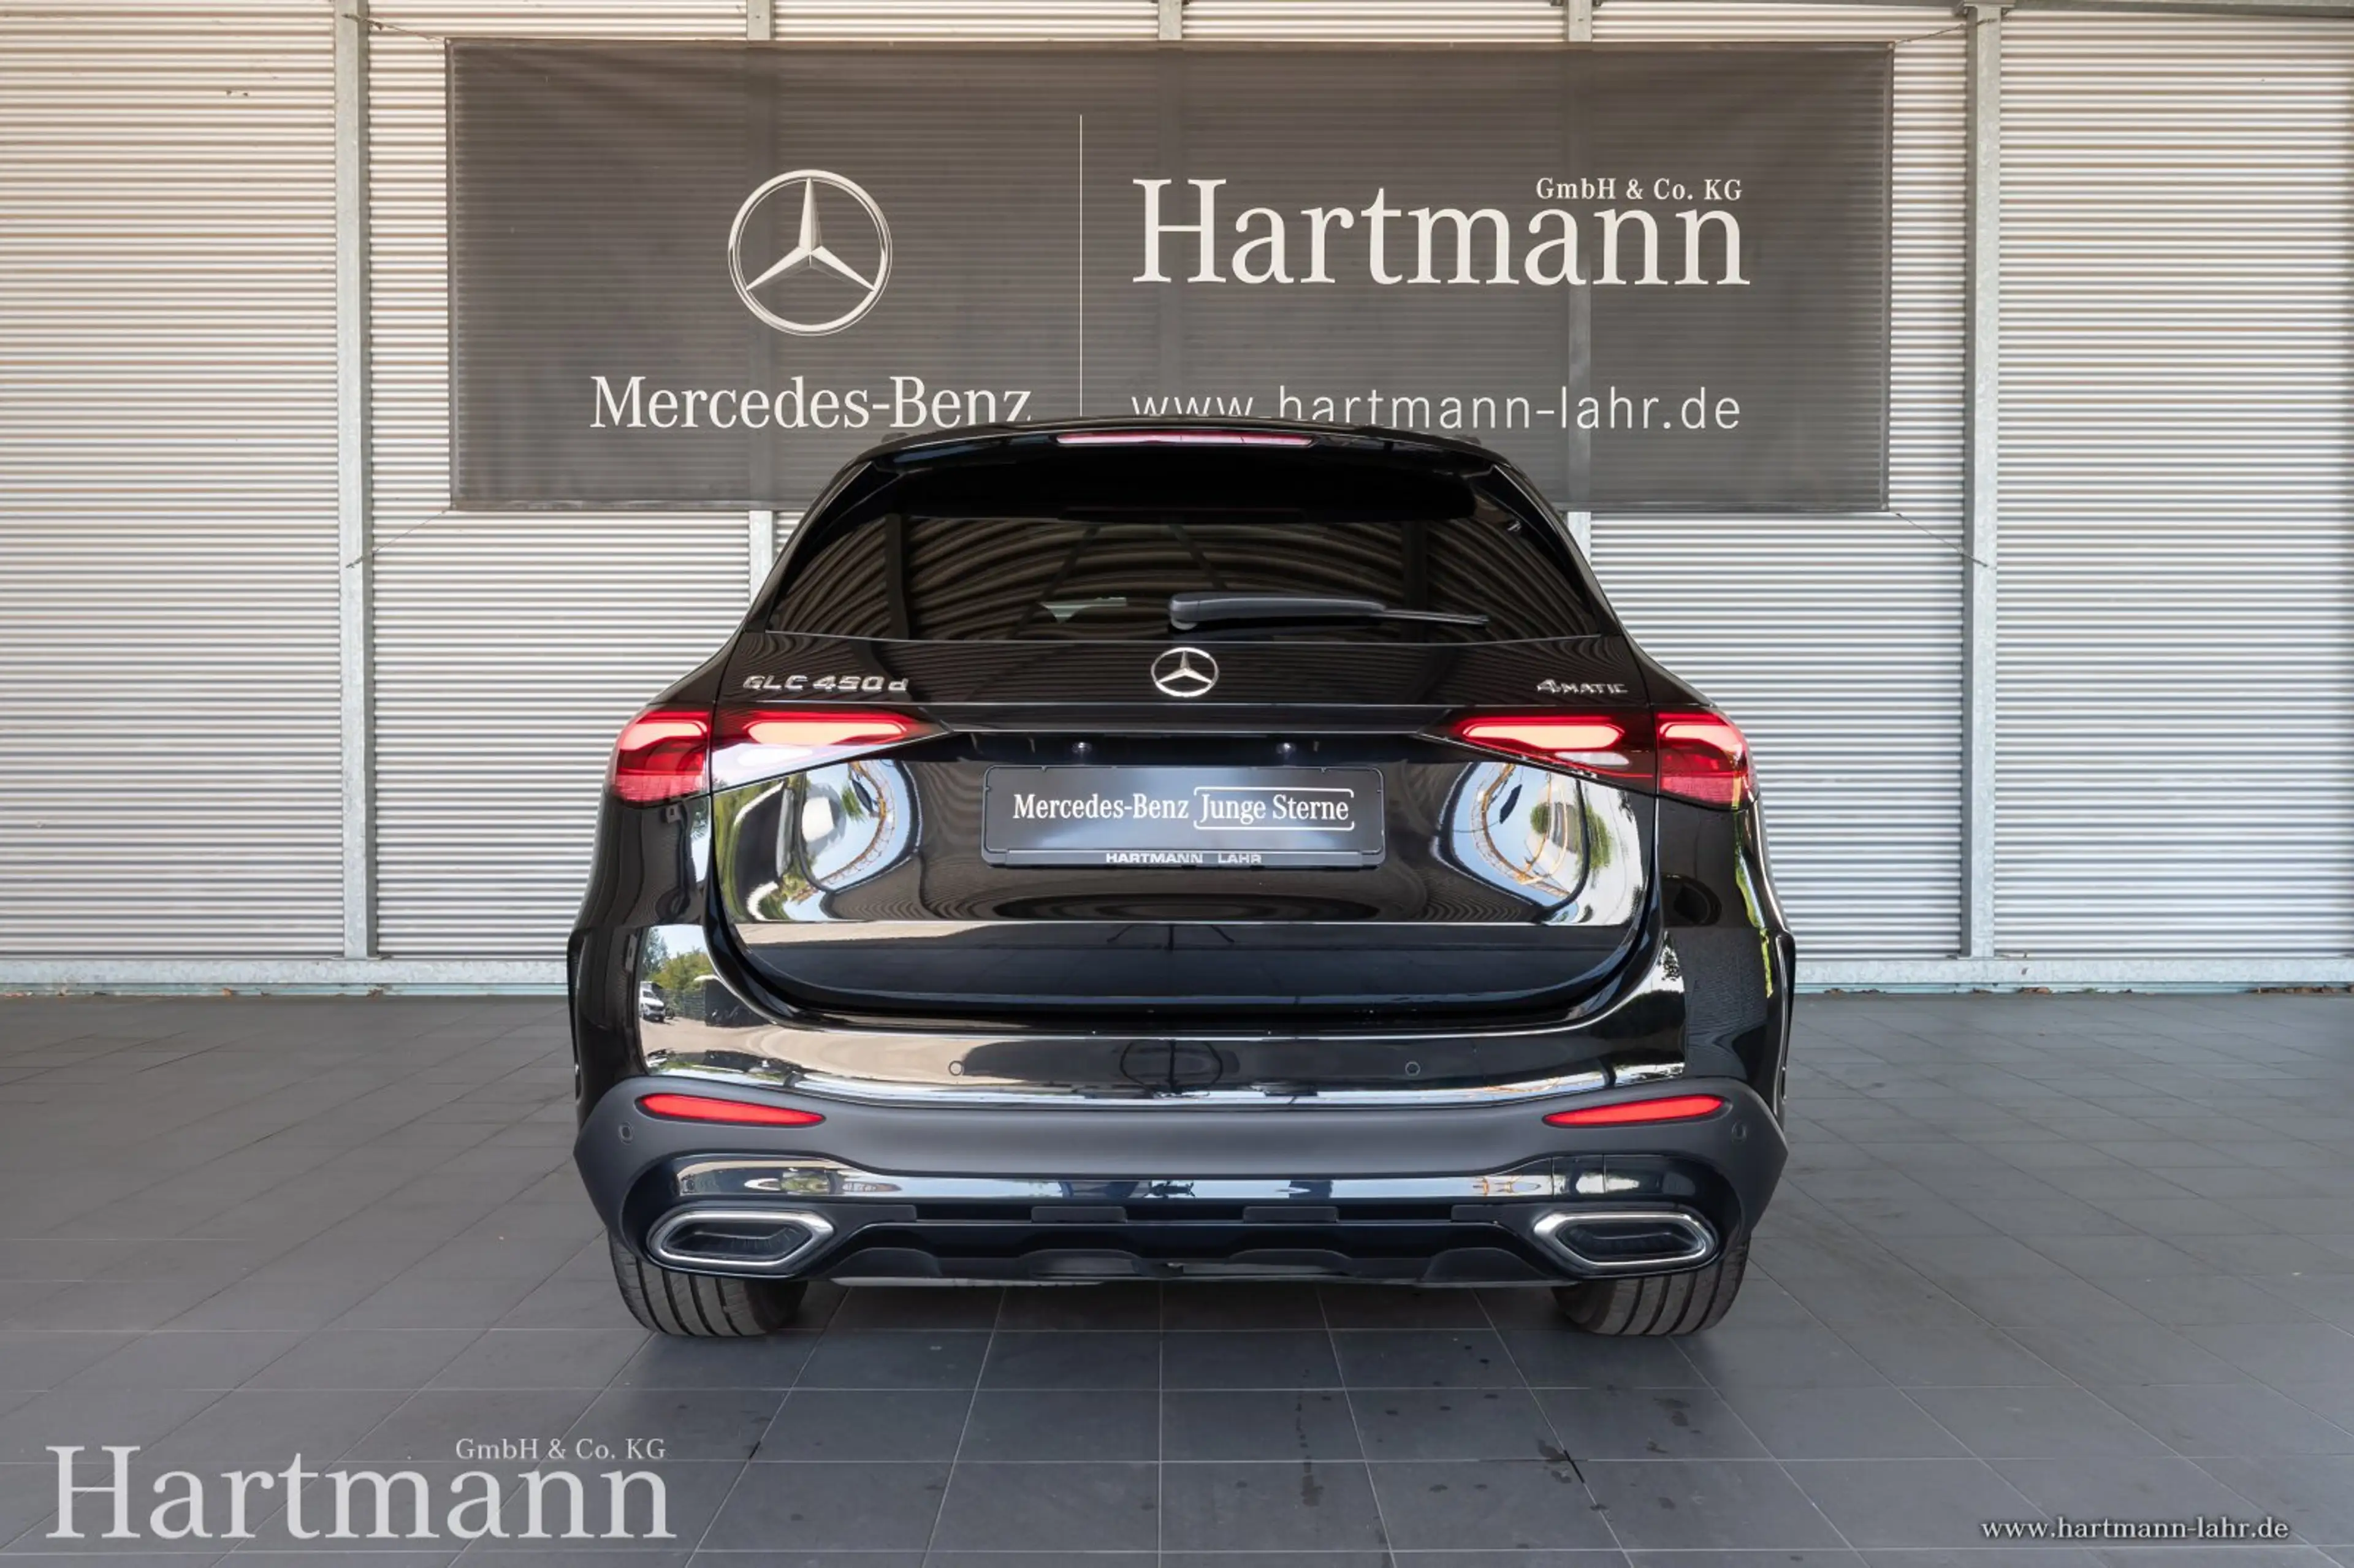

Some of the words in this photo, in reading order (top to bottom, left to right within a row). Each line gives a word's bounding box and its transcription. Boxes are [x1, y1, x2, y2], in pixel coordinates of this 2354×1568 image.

[1536, 177, 1616, 200] GmbH
[1626, 178, 1644, 200] &
[1653, 177, 1694, 200] Co.
[1704, 178, 1742, 200] KG
[1132, 177, 1751, 286] Hartmann
[590, 375, 1032, 433] Mercedes-Benz
[1131, 384, 1740, 430] wwwhartmann-lahr.de
[742, 674, 809, 691] GLC
[812, 675, 885, 692] 450
[887, 677, 909, 692] d
[1013, 792, 1190, 822] Mercedes-Benz
[1198, 793, 1267, 825] Junge
[1271, 793, 1349, 821] Sterne
[1105, 851, 1204, 865] HARTMANN
[1217, 851, 1263, 865] LAHR
